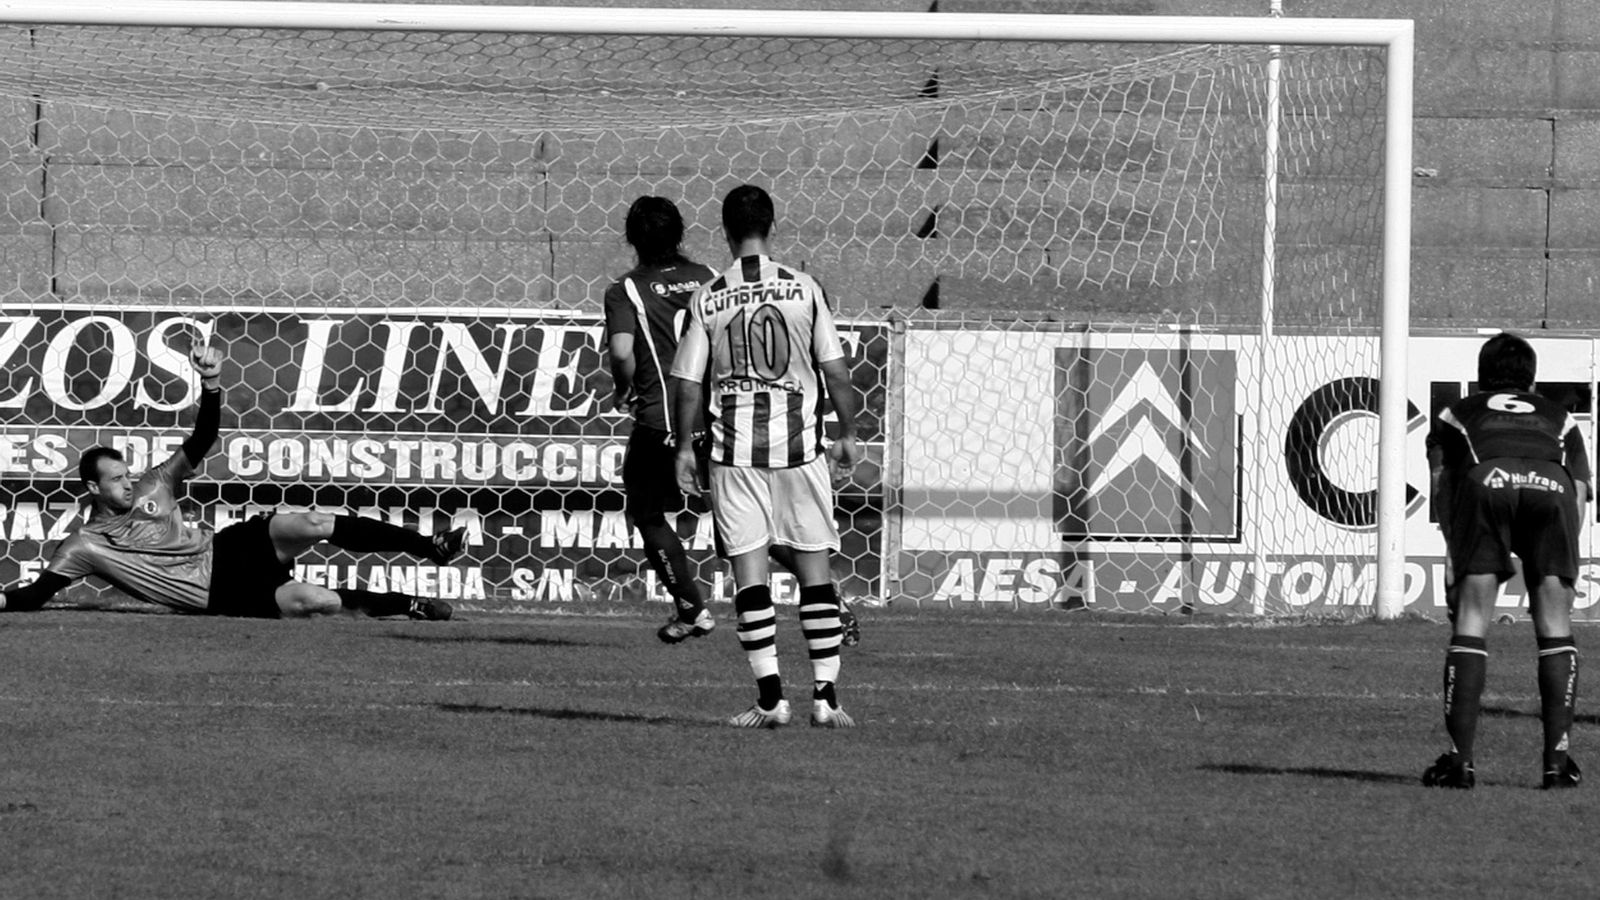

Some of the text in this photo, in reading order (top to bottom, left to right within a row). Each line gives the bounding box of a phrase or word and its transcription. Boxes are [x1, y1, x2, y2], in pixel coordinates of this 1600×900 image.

[724, 303, 791, 381] 10
[281, 319, 634, 417] LINE
[1487, 393, 1536, 414] 6
[511, 567, 573, 601] S/N
[933, 557, 1096, 604] AESA
